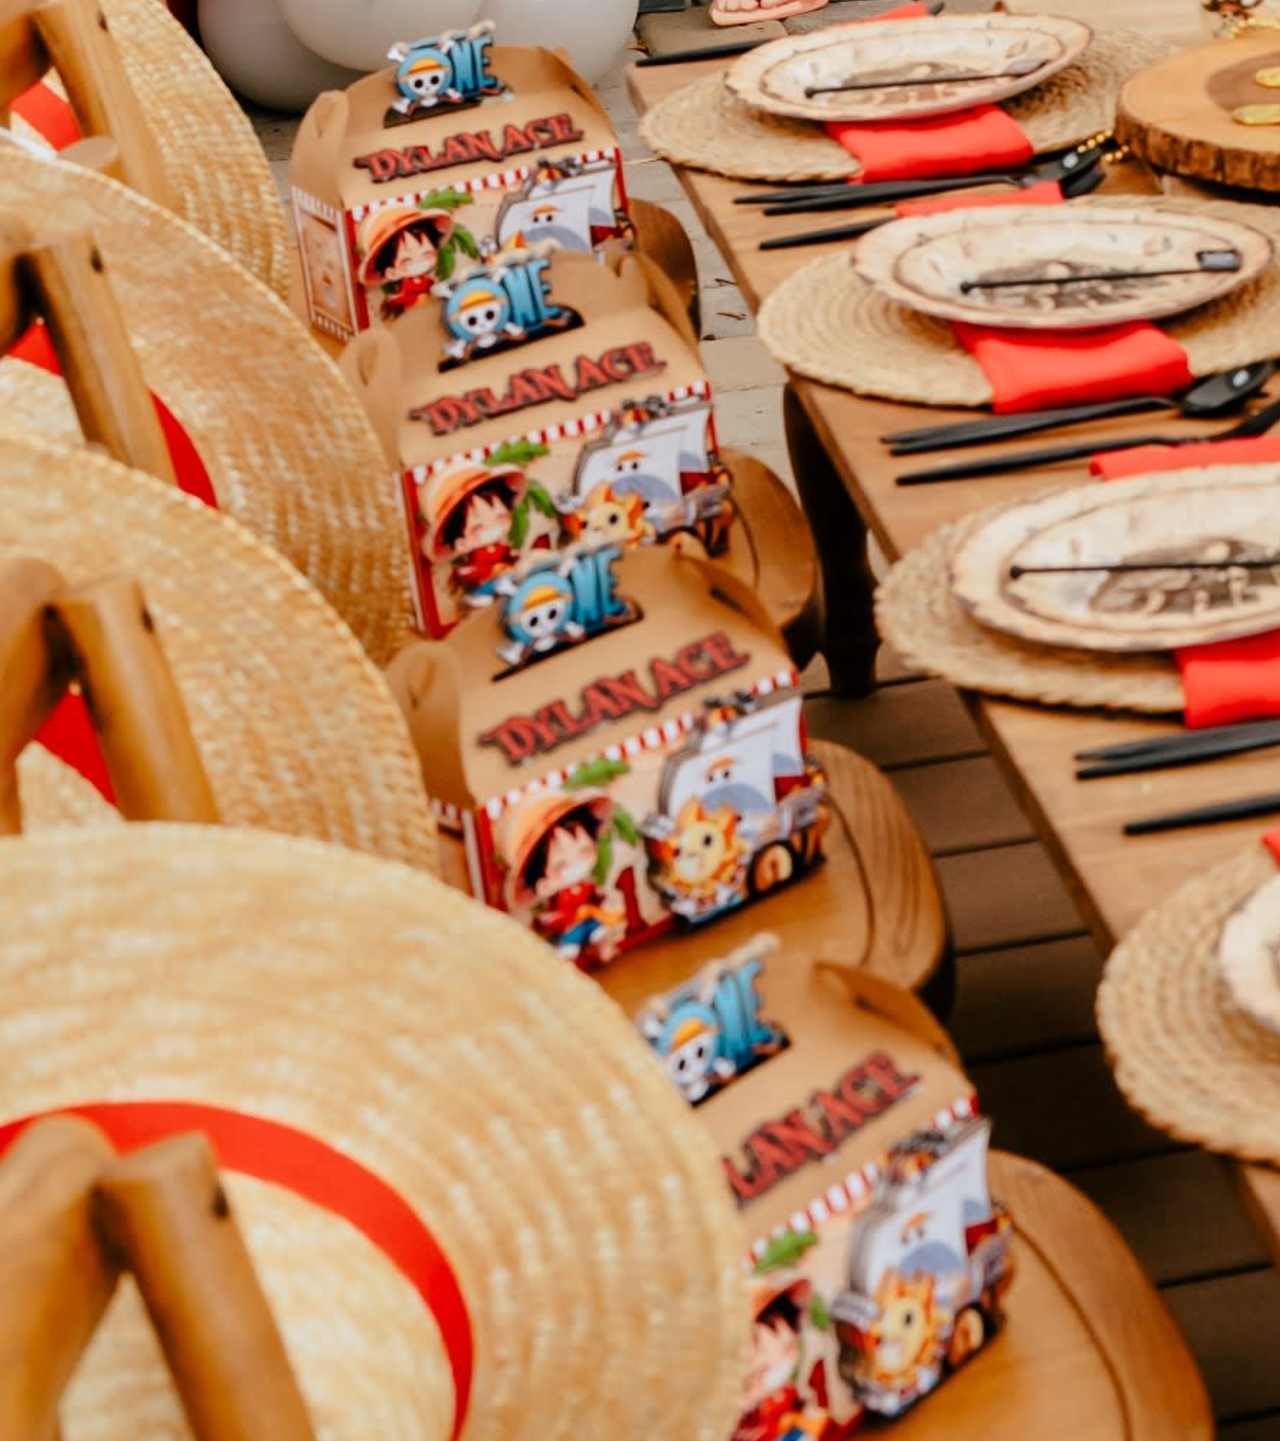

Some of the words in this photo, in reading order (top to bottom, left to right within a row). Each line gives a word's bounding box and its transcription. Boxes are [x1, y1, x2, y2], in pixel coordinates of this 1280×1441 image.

[353, 125, 500, 185] DYLAN
[500, 113, 584, 162] ACE
[410, 362, 577, 438] DYLAN
[575, 340, 668, 393] ACE
[478, 660, 660, 768] DYLAN
[654, 630, 753, 697] ACE
[812, 1050, 922, 1140] ACE
